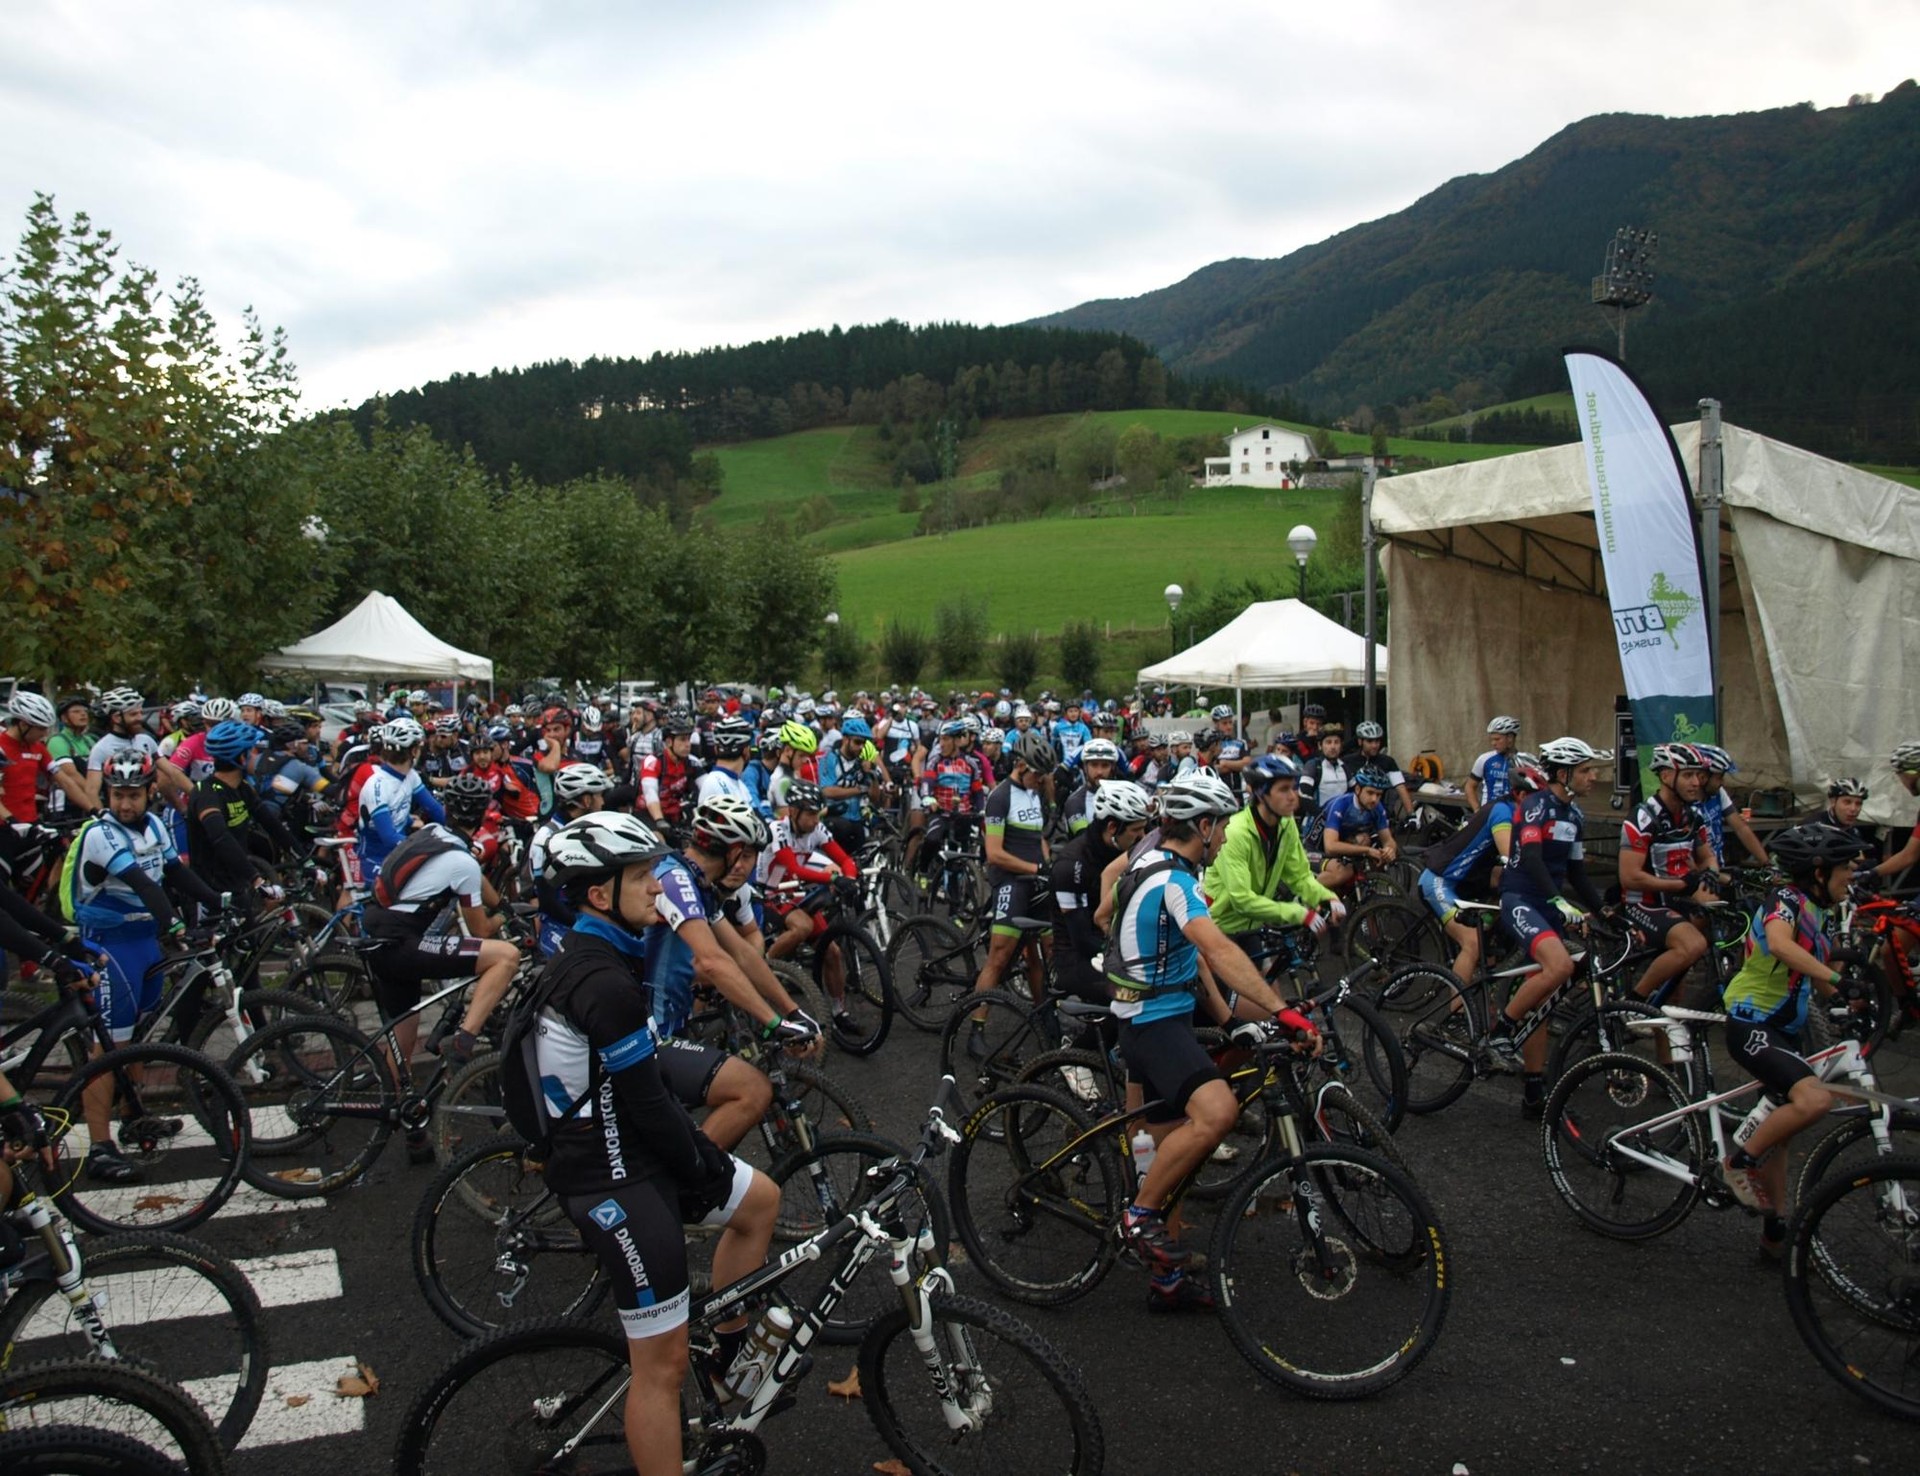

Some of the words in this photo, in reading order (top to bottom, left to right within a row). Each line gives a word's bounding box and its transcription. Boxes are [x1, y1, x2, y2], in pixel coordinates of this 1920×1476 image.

[995, 884, 1013, 921] BESA
[614, 1227, 650, 1288] DANOBAT
[1427, 1225, 1446, 1289] MAXXIS
[773, 1245, 881, 1384] CUBE
